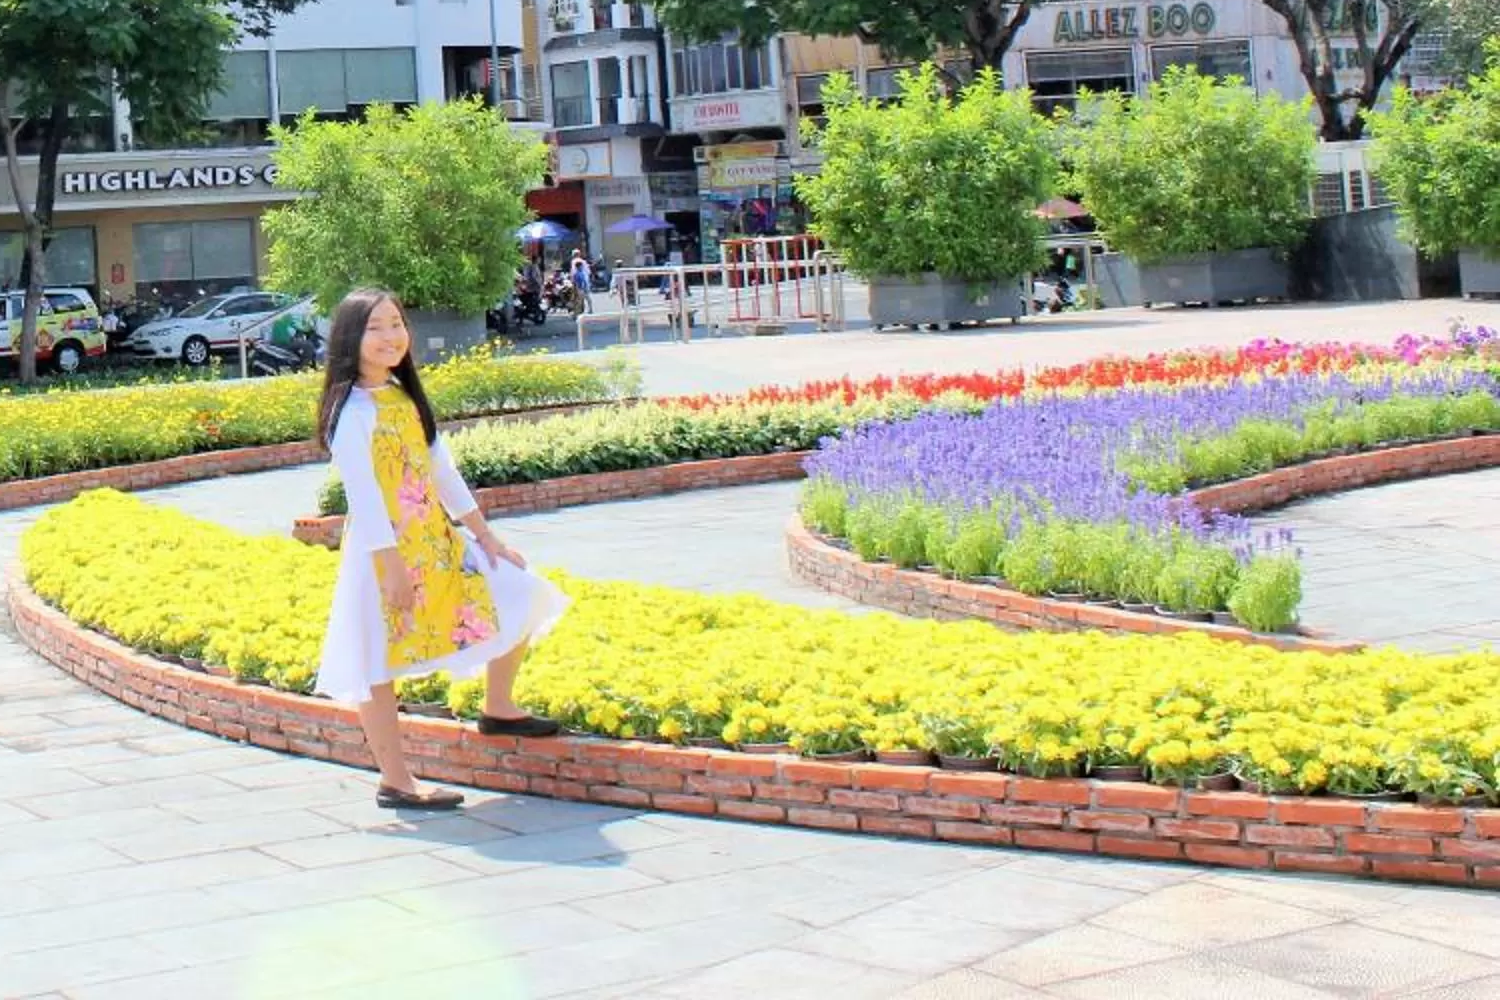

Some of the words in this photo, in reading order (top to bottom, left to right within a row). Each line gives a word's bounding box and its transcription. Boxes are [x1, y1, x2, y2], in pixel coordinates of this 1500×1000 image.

[1053, 6, 1138, 43] ALLEZ
[1146, 1, 1216, 38] BOO
[64, 164, 254, 194] HIGHLANDS
